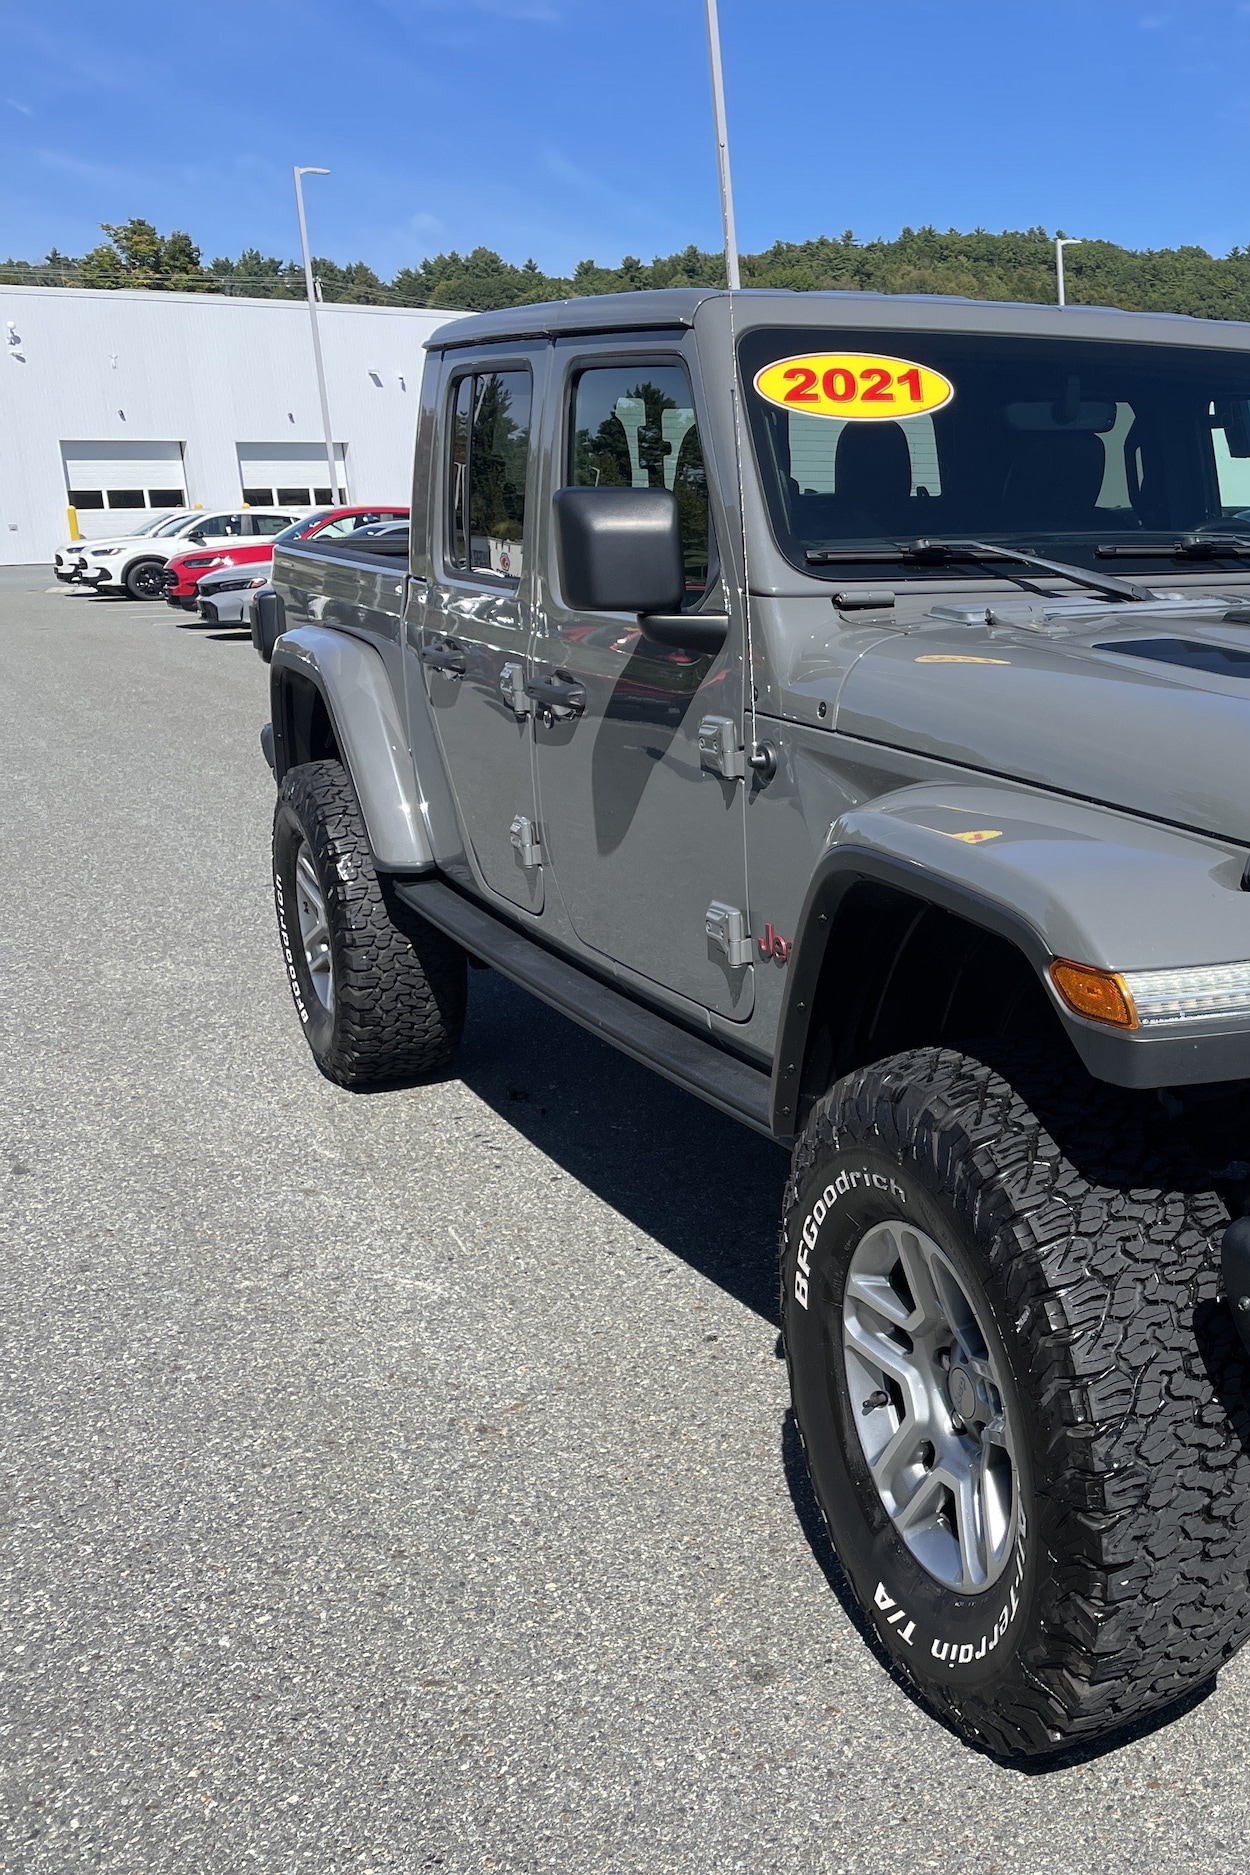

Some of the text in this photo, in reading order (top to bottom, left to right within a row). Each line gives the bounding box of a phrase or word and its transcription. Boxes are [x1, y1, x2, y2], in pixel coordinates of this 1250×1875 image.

[782, 367, 924, 403] 2021
[793, 1166, 907, 1311] BFGoodrich
[872, 1581, 918, 1647] T/A
